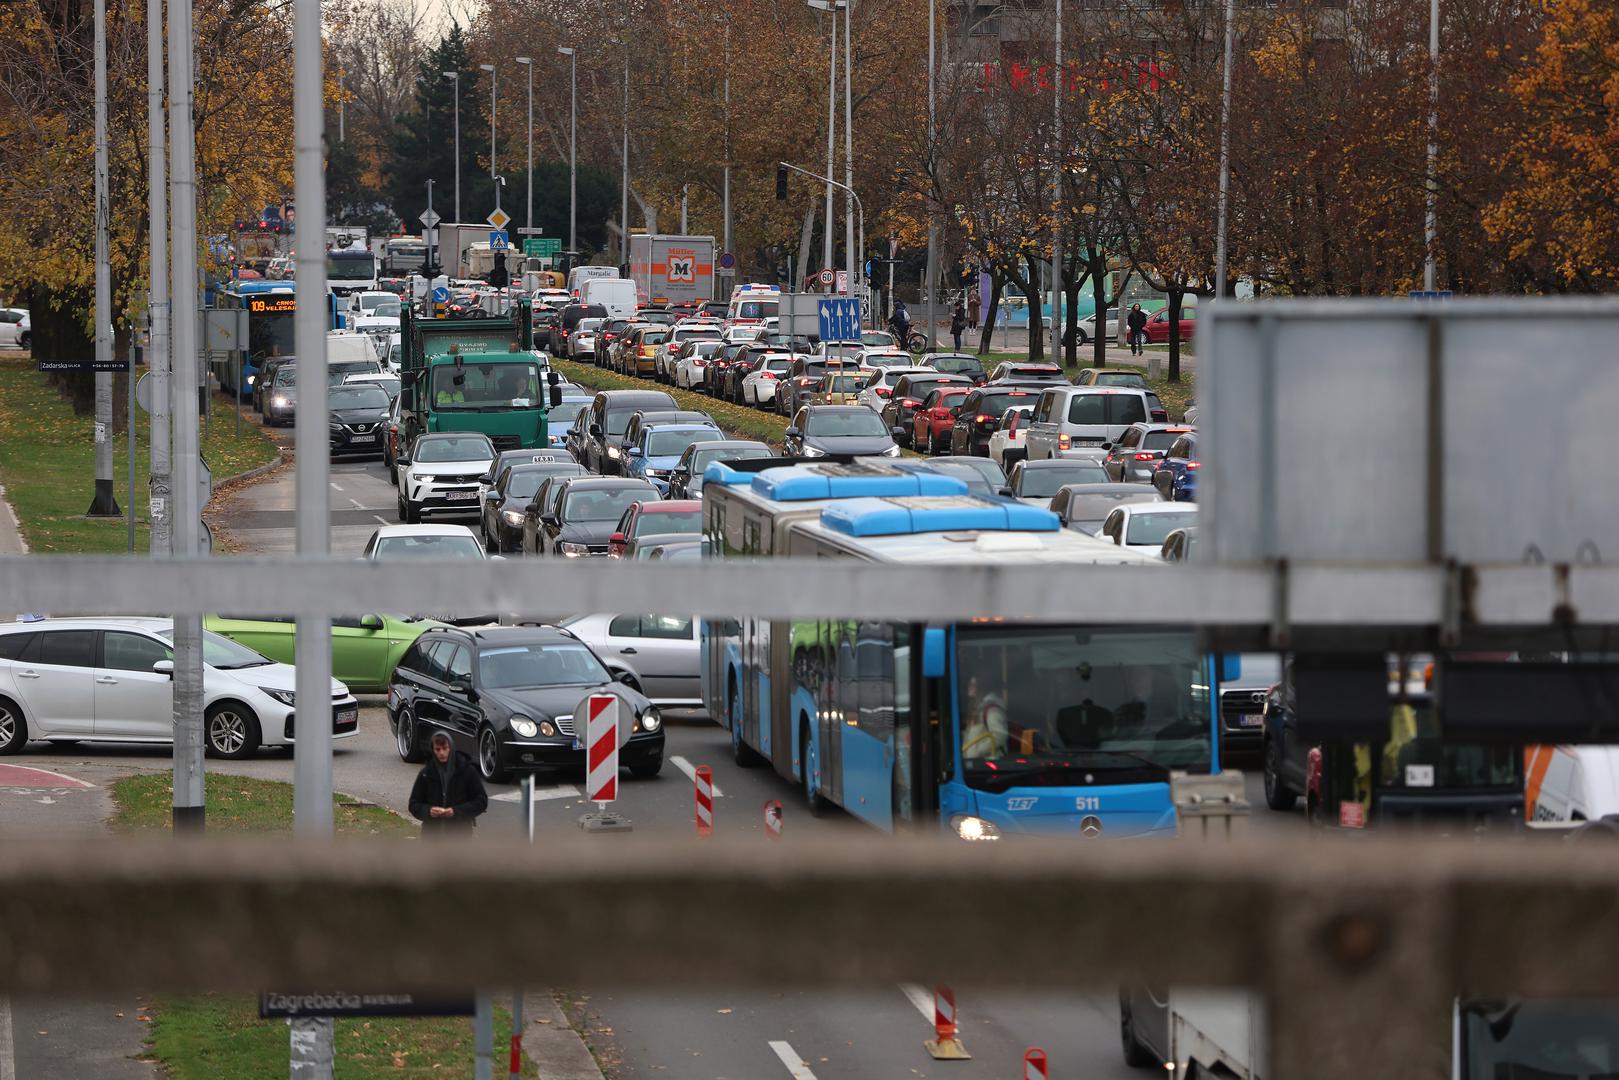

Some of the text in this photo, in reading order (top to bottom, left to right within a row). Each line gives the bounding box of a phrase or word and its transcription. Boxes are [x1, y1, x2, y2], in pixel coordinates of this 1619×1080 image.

[673, 262, 689, 275] M
[822, 273, 832, 282] 60
[251, 300, 265, 311] 109
[1008, 797, 1039, 811] ZET
[1076, 797, 1099, 811] 511
[268, 991, 362, 1013] Zagrebačka
